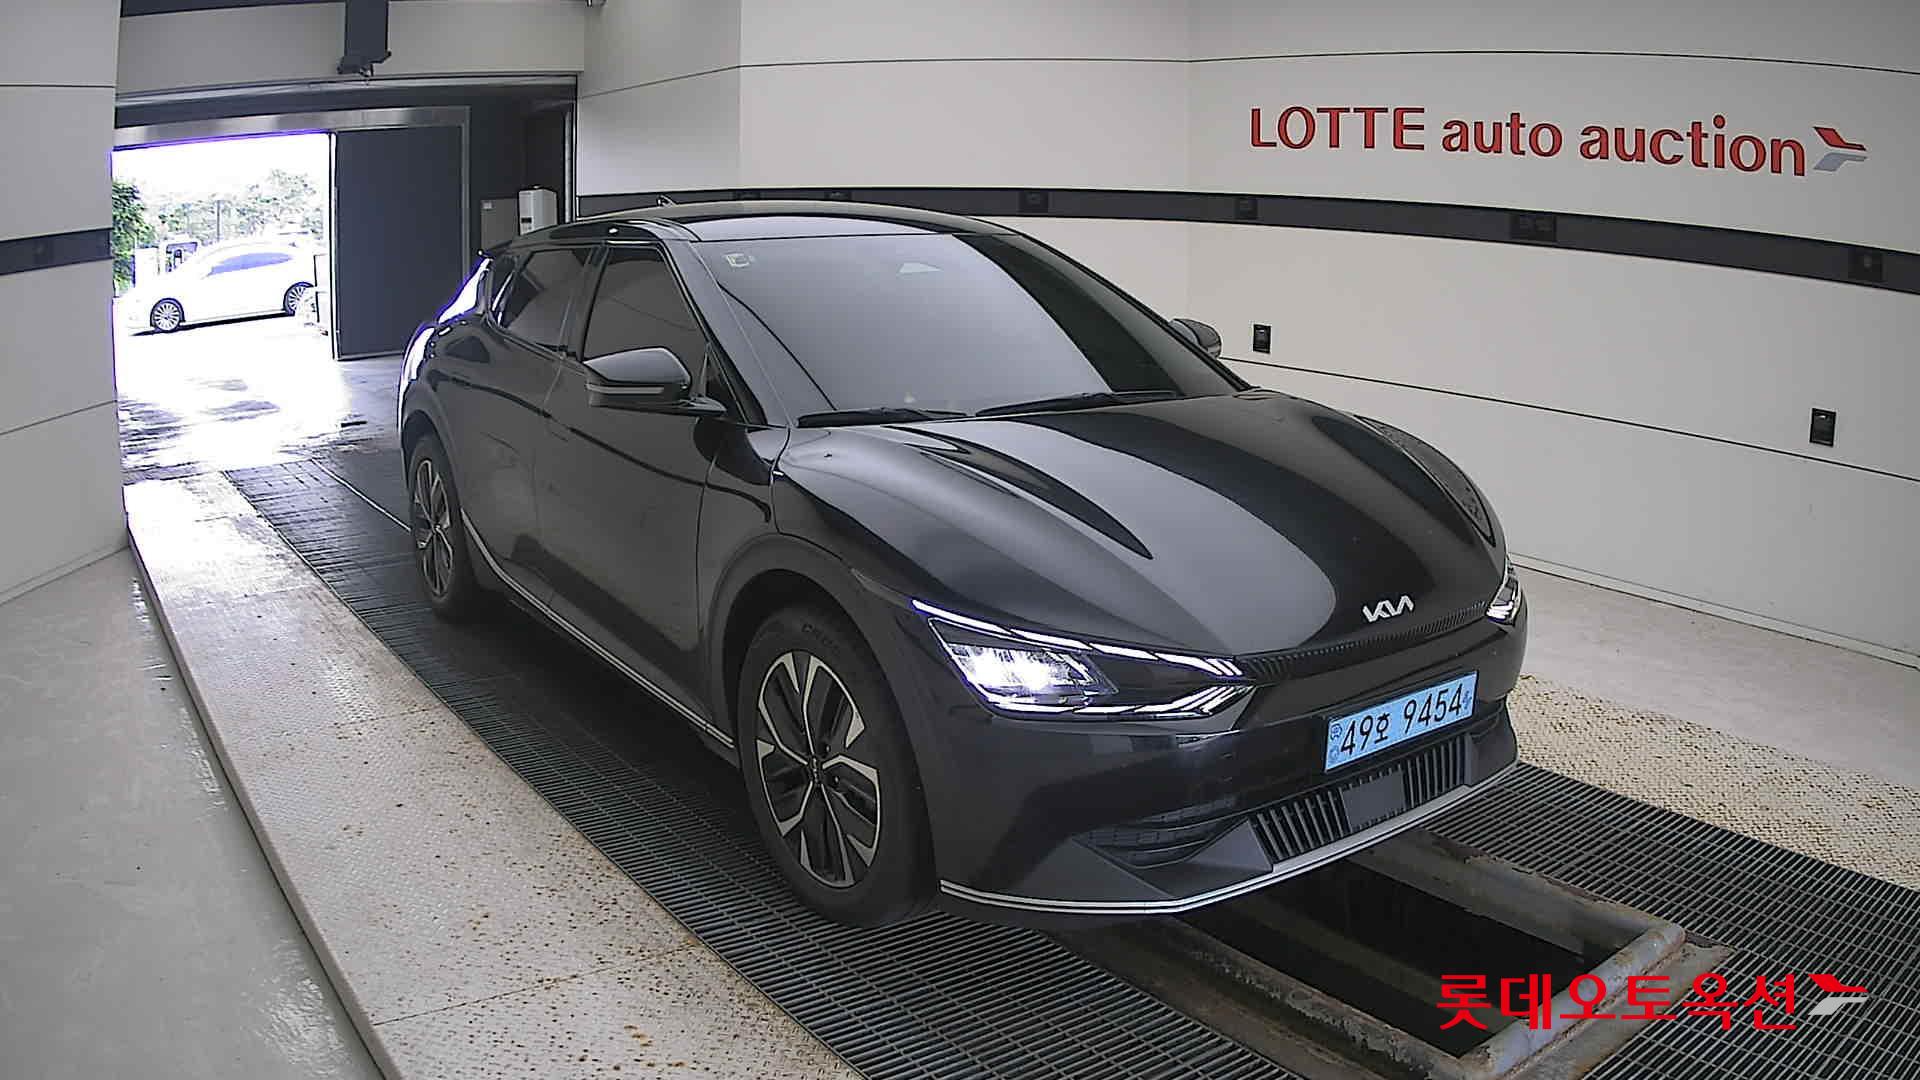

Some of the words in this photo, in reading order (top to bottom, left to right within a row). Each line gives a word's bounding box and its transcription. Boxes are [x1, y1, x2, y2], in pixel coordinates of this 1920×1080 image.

[1251, 107, 1425, 150] LOTTE
[1442, 113, 1562, 157] auto
[1580, 115, 1806, 176] auction
[1341, 711, 1390, 755] 49호
[1404, 684, 1463, 734] 9454
